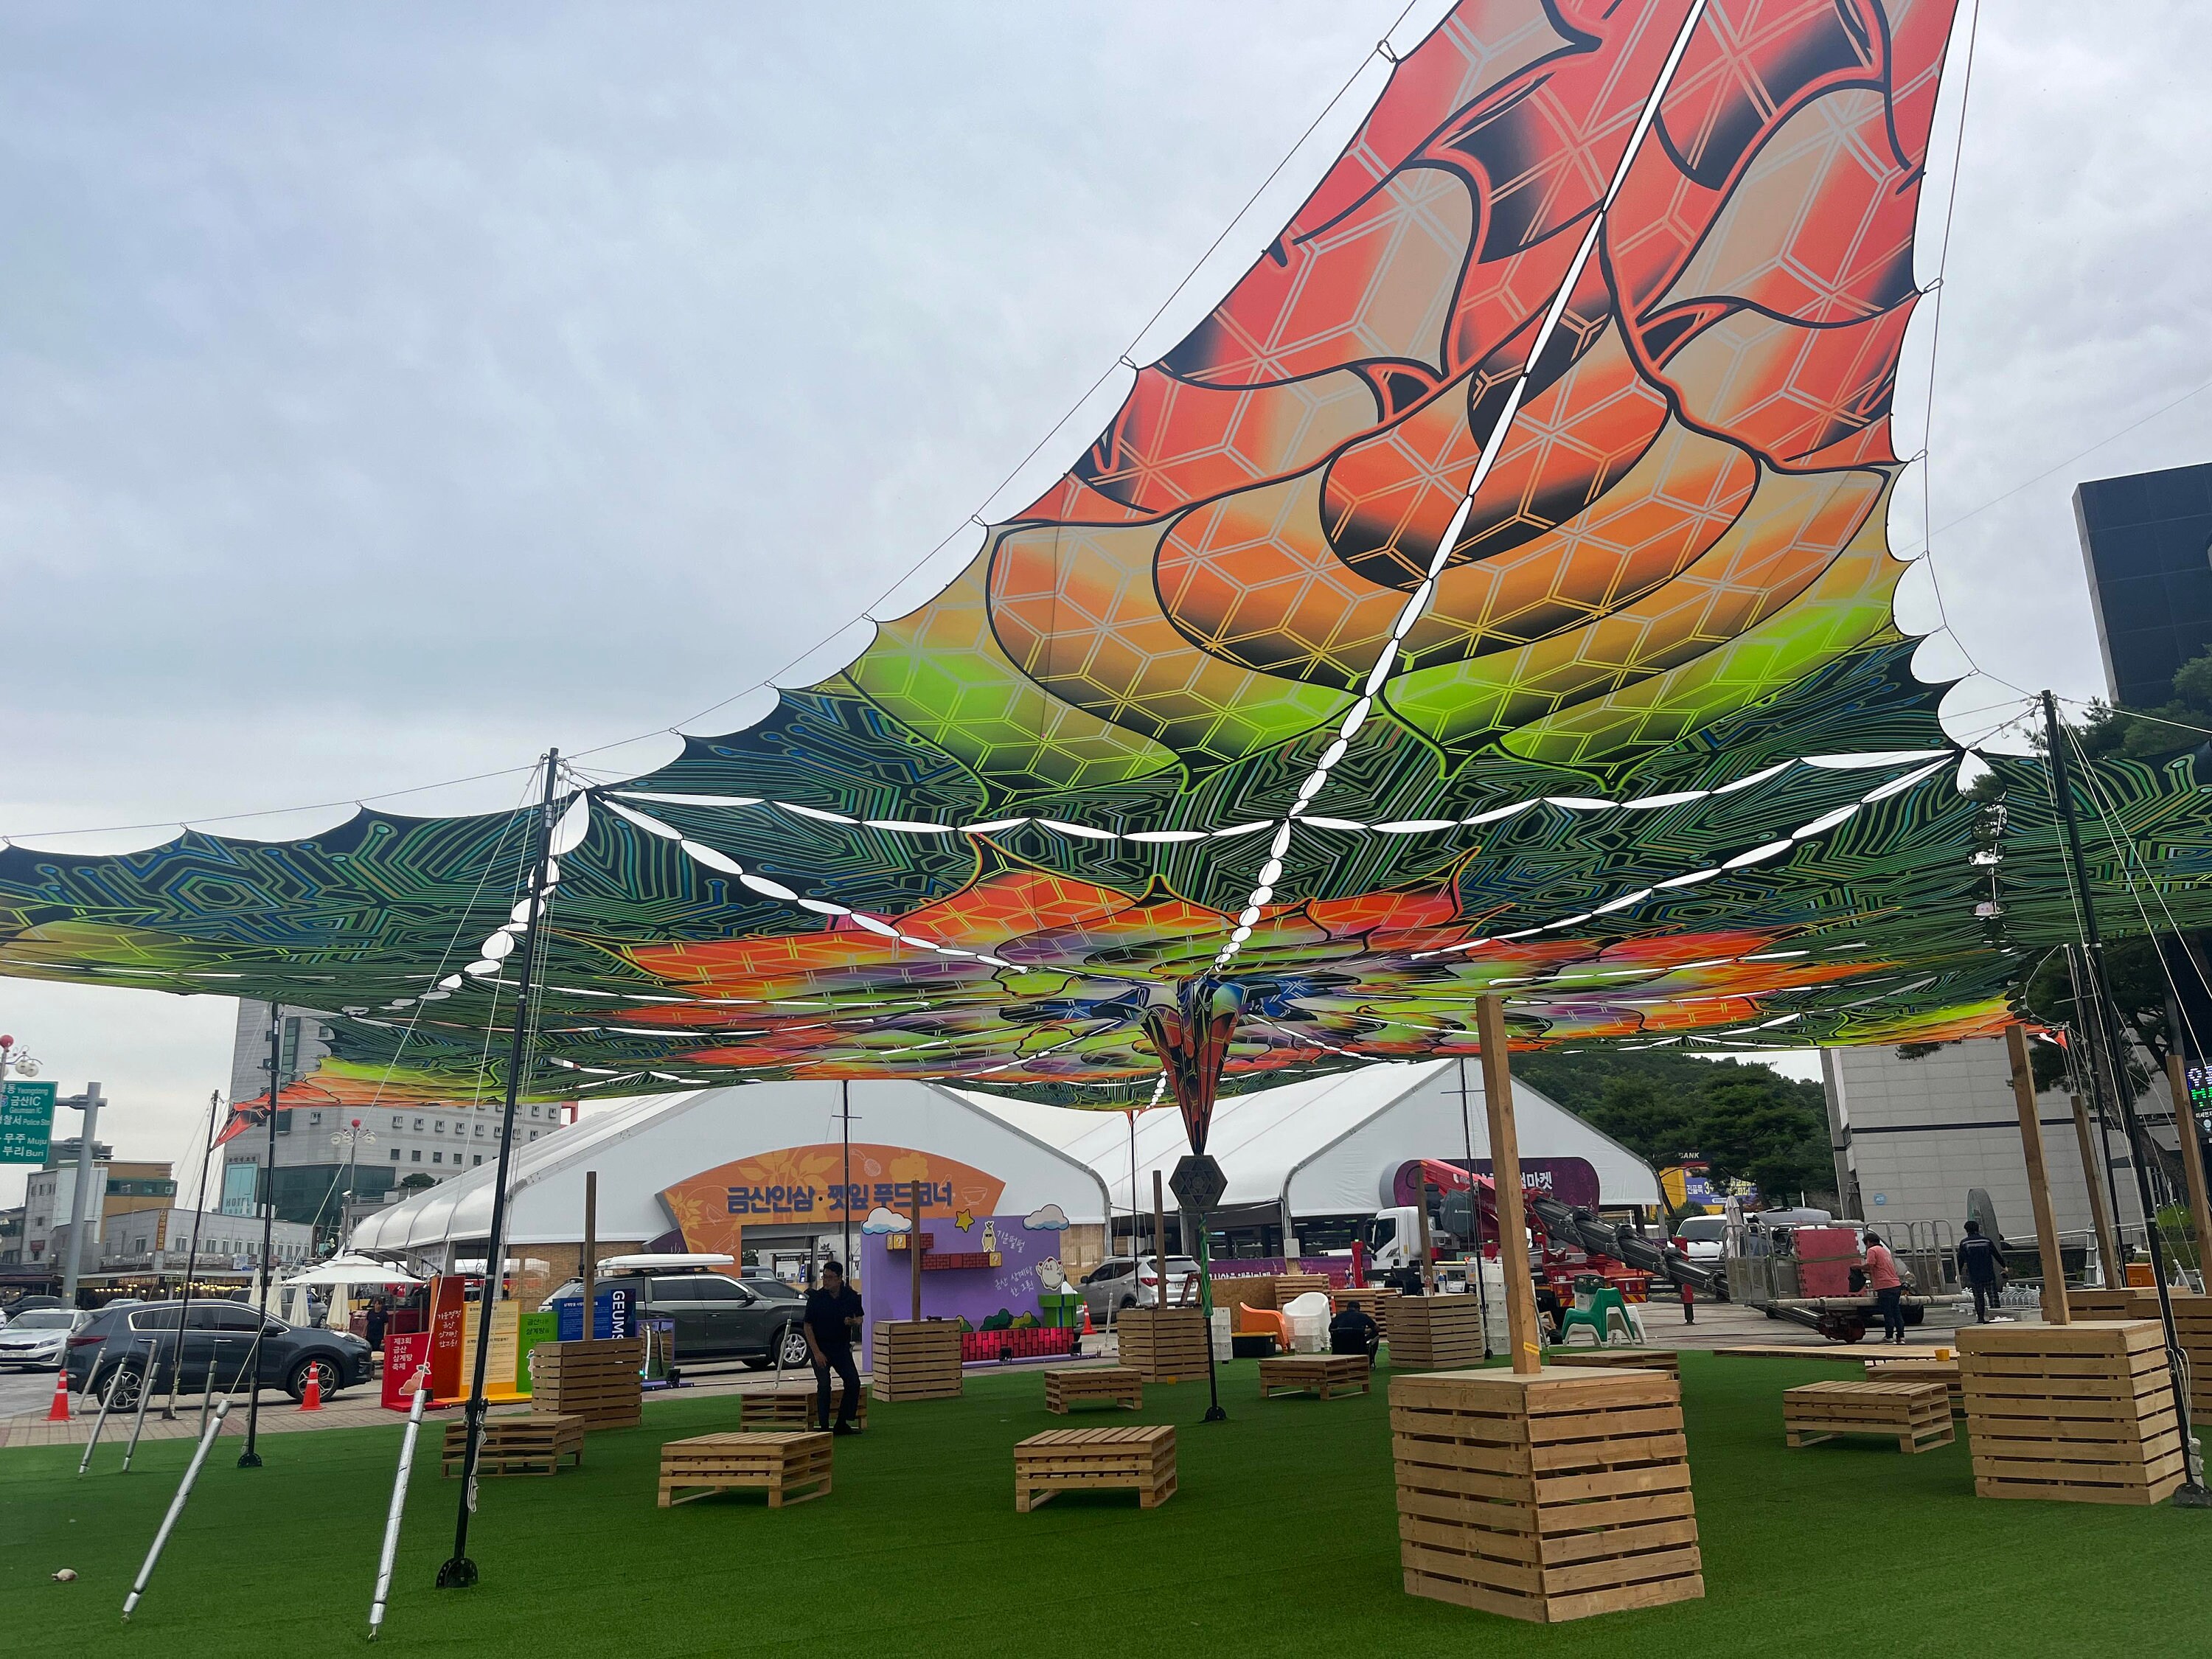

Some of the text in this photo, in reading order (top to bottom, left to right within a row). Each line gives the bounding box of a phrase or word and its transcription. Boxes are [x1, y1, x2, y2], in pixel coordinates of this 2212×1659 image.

[10, 1096, 41, 1106] 금산IC
[4, 1133, 47, 1146] 무주 Muju
[3, 1146, 24, 1156] 부리
[394, 1337, 412, 1345] 제3회
[393, 1346, 407, 1354] 금산
[393, 1354, 413, 1363] 삼계탕
[392, 1363, 406, 1371] 축제
